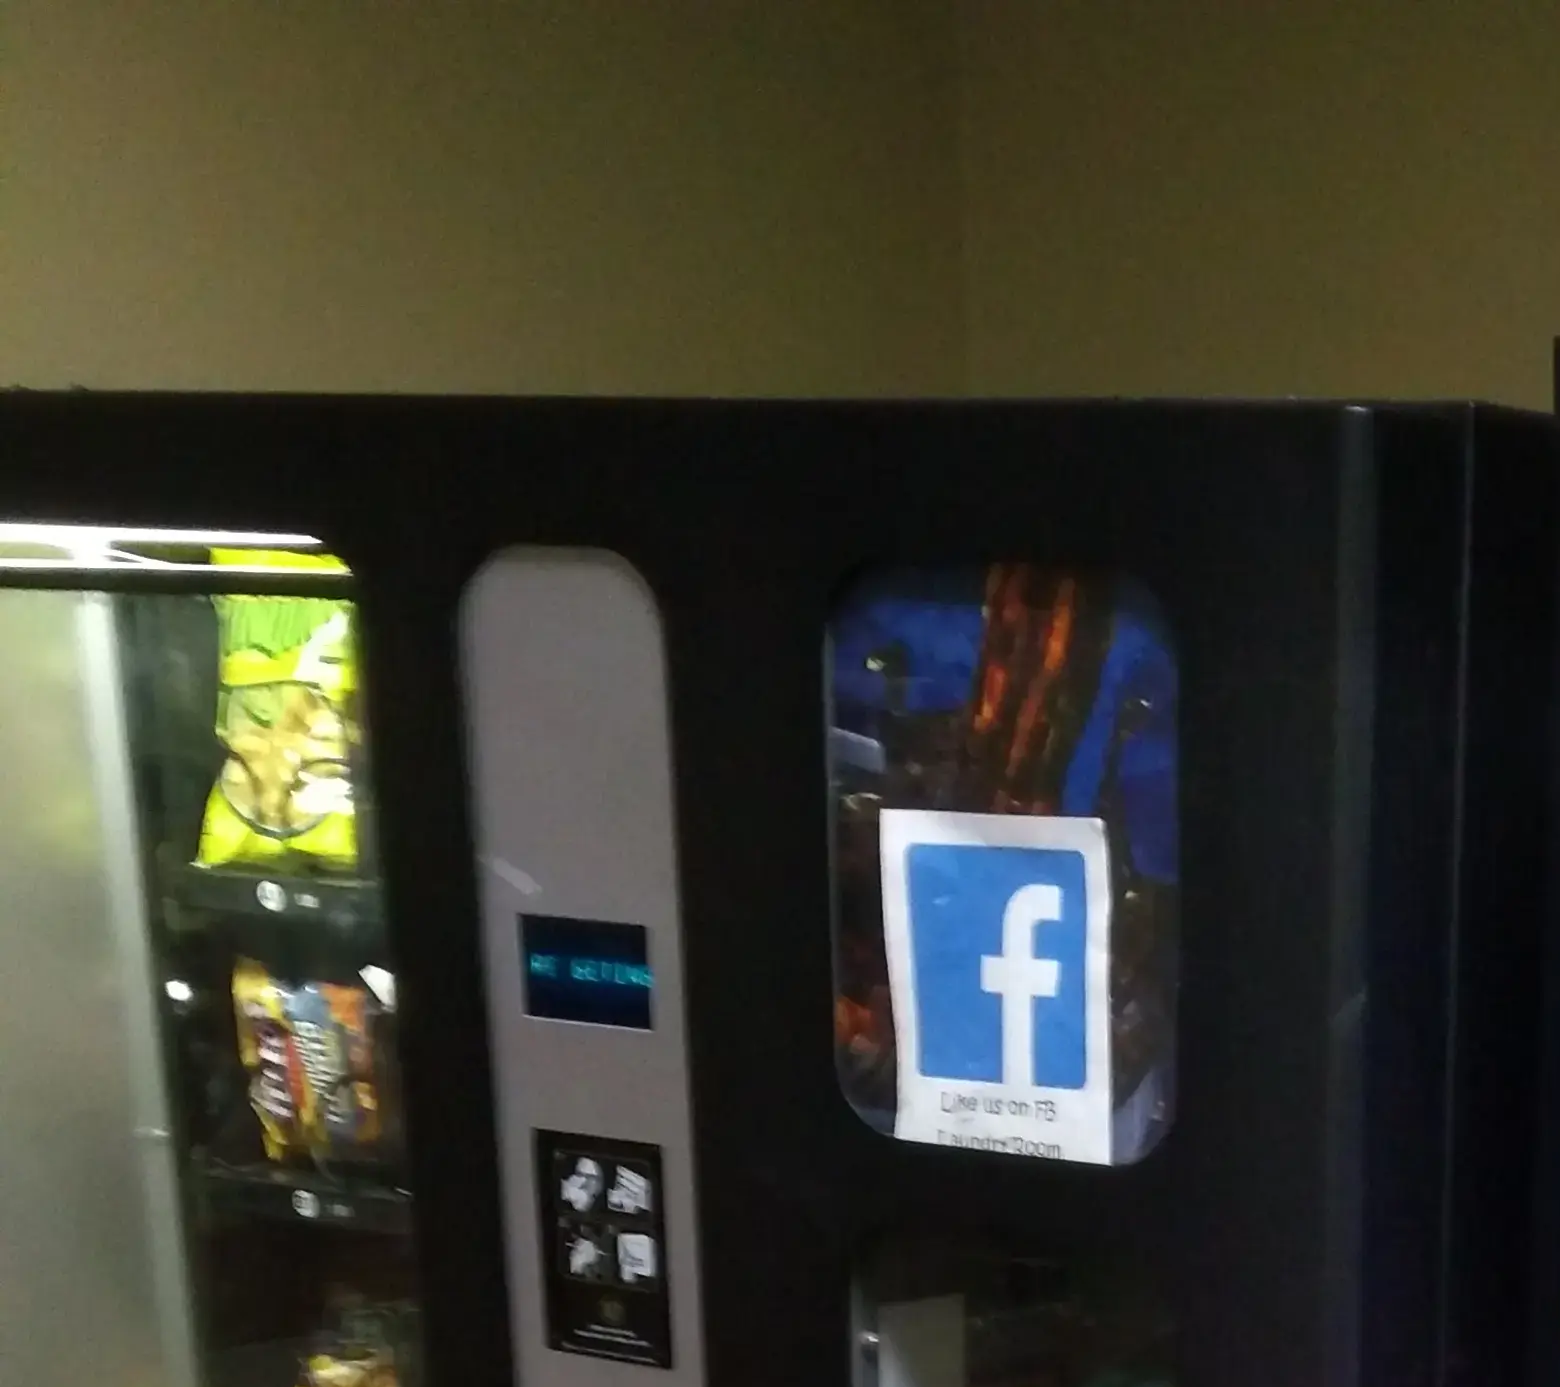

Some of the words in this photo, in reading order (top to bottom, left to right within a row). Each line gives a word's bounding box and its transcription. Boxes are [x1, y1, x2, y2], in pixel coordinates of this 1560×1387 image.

[940, 1091, 978, 1113] Like
[983, 1097, 1003, 1115] us
[1007, 1099, 1030, 1116] on
[1034, 1100, 1057, 1122] FB
